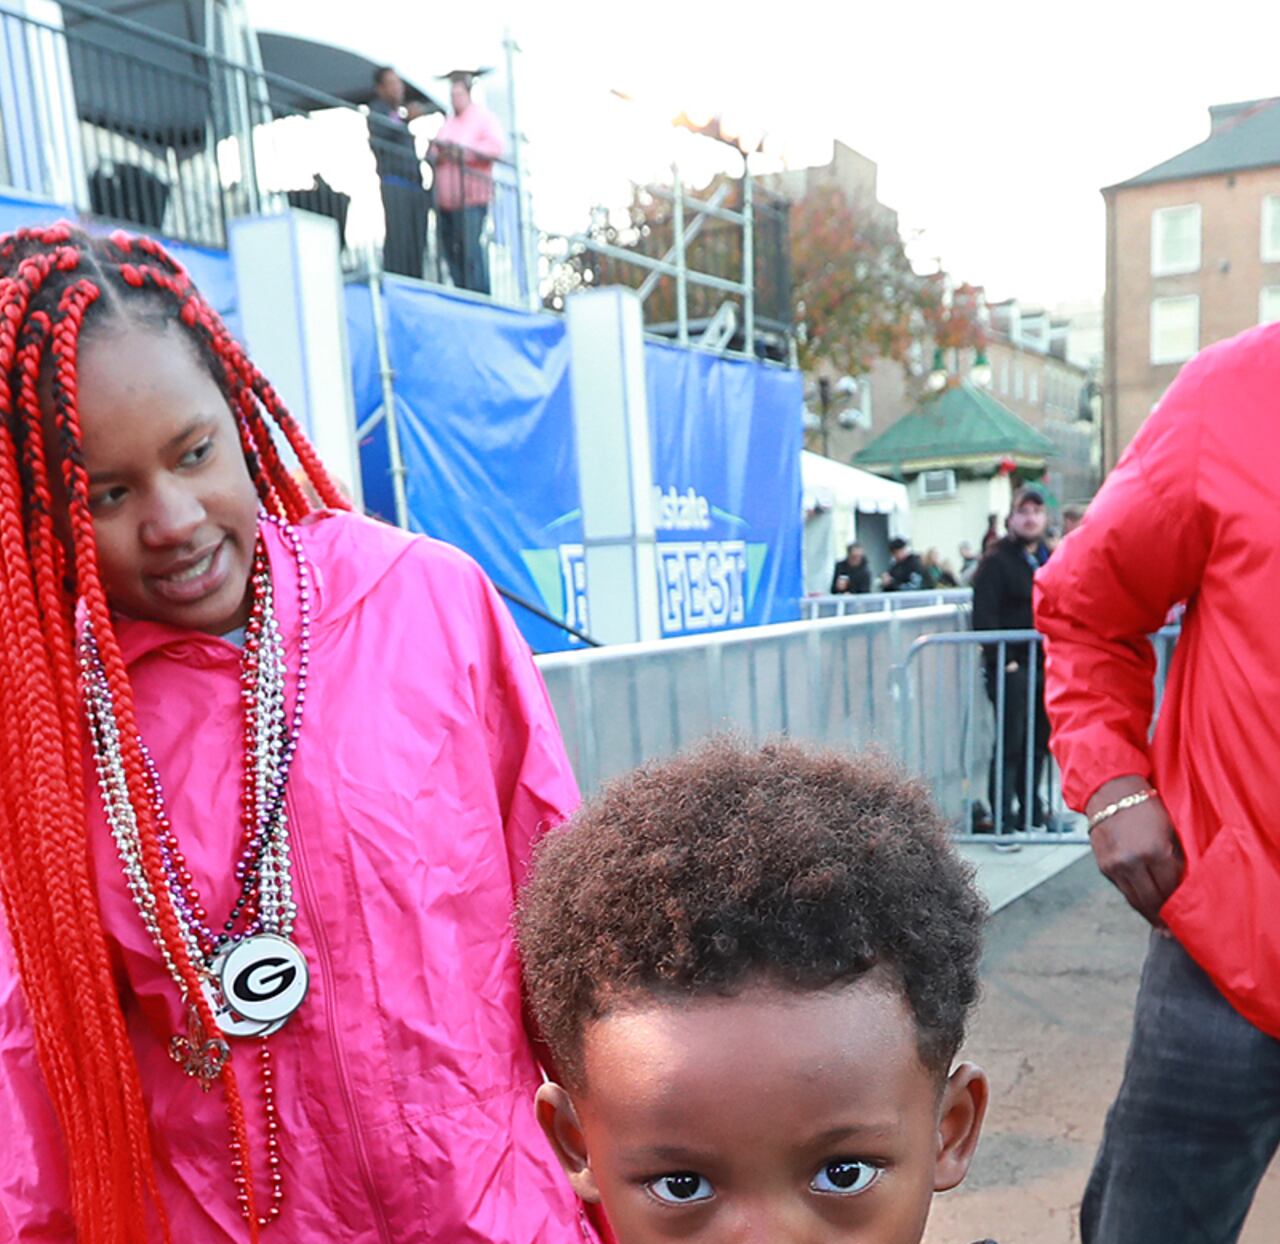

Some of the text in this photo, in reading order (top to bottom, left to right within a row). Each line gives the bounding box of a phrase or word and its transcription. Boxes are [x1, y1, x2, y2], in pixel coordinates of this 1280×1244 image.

[653, 485, 713, 530] lstate
[656, 540, 747, 632] FEST
[232, 956, 297, 1002] G
